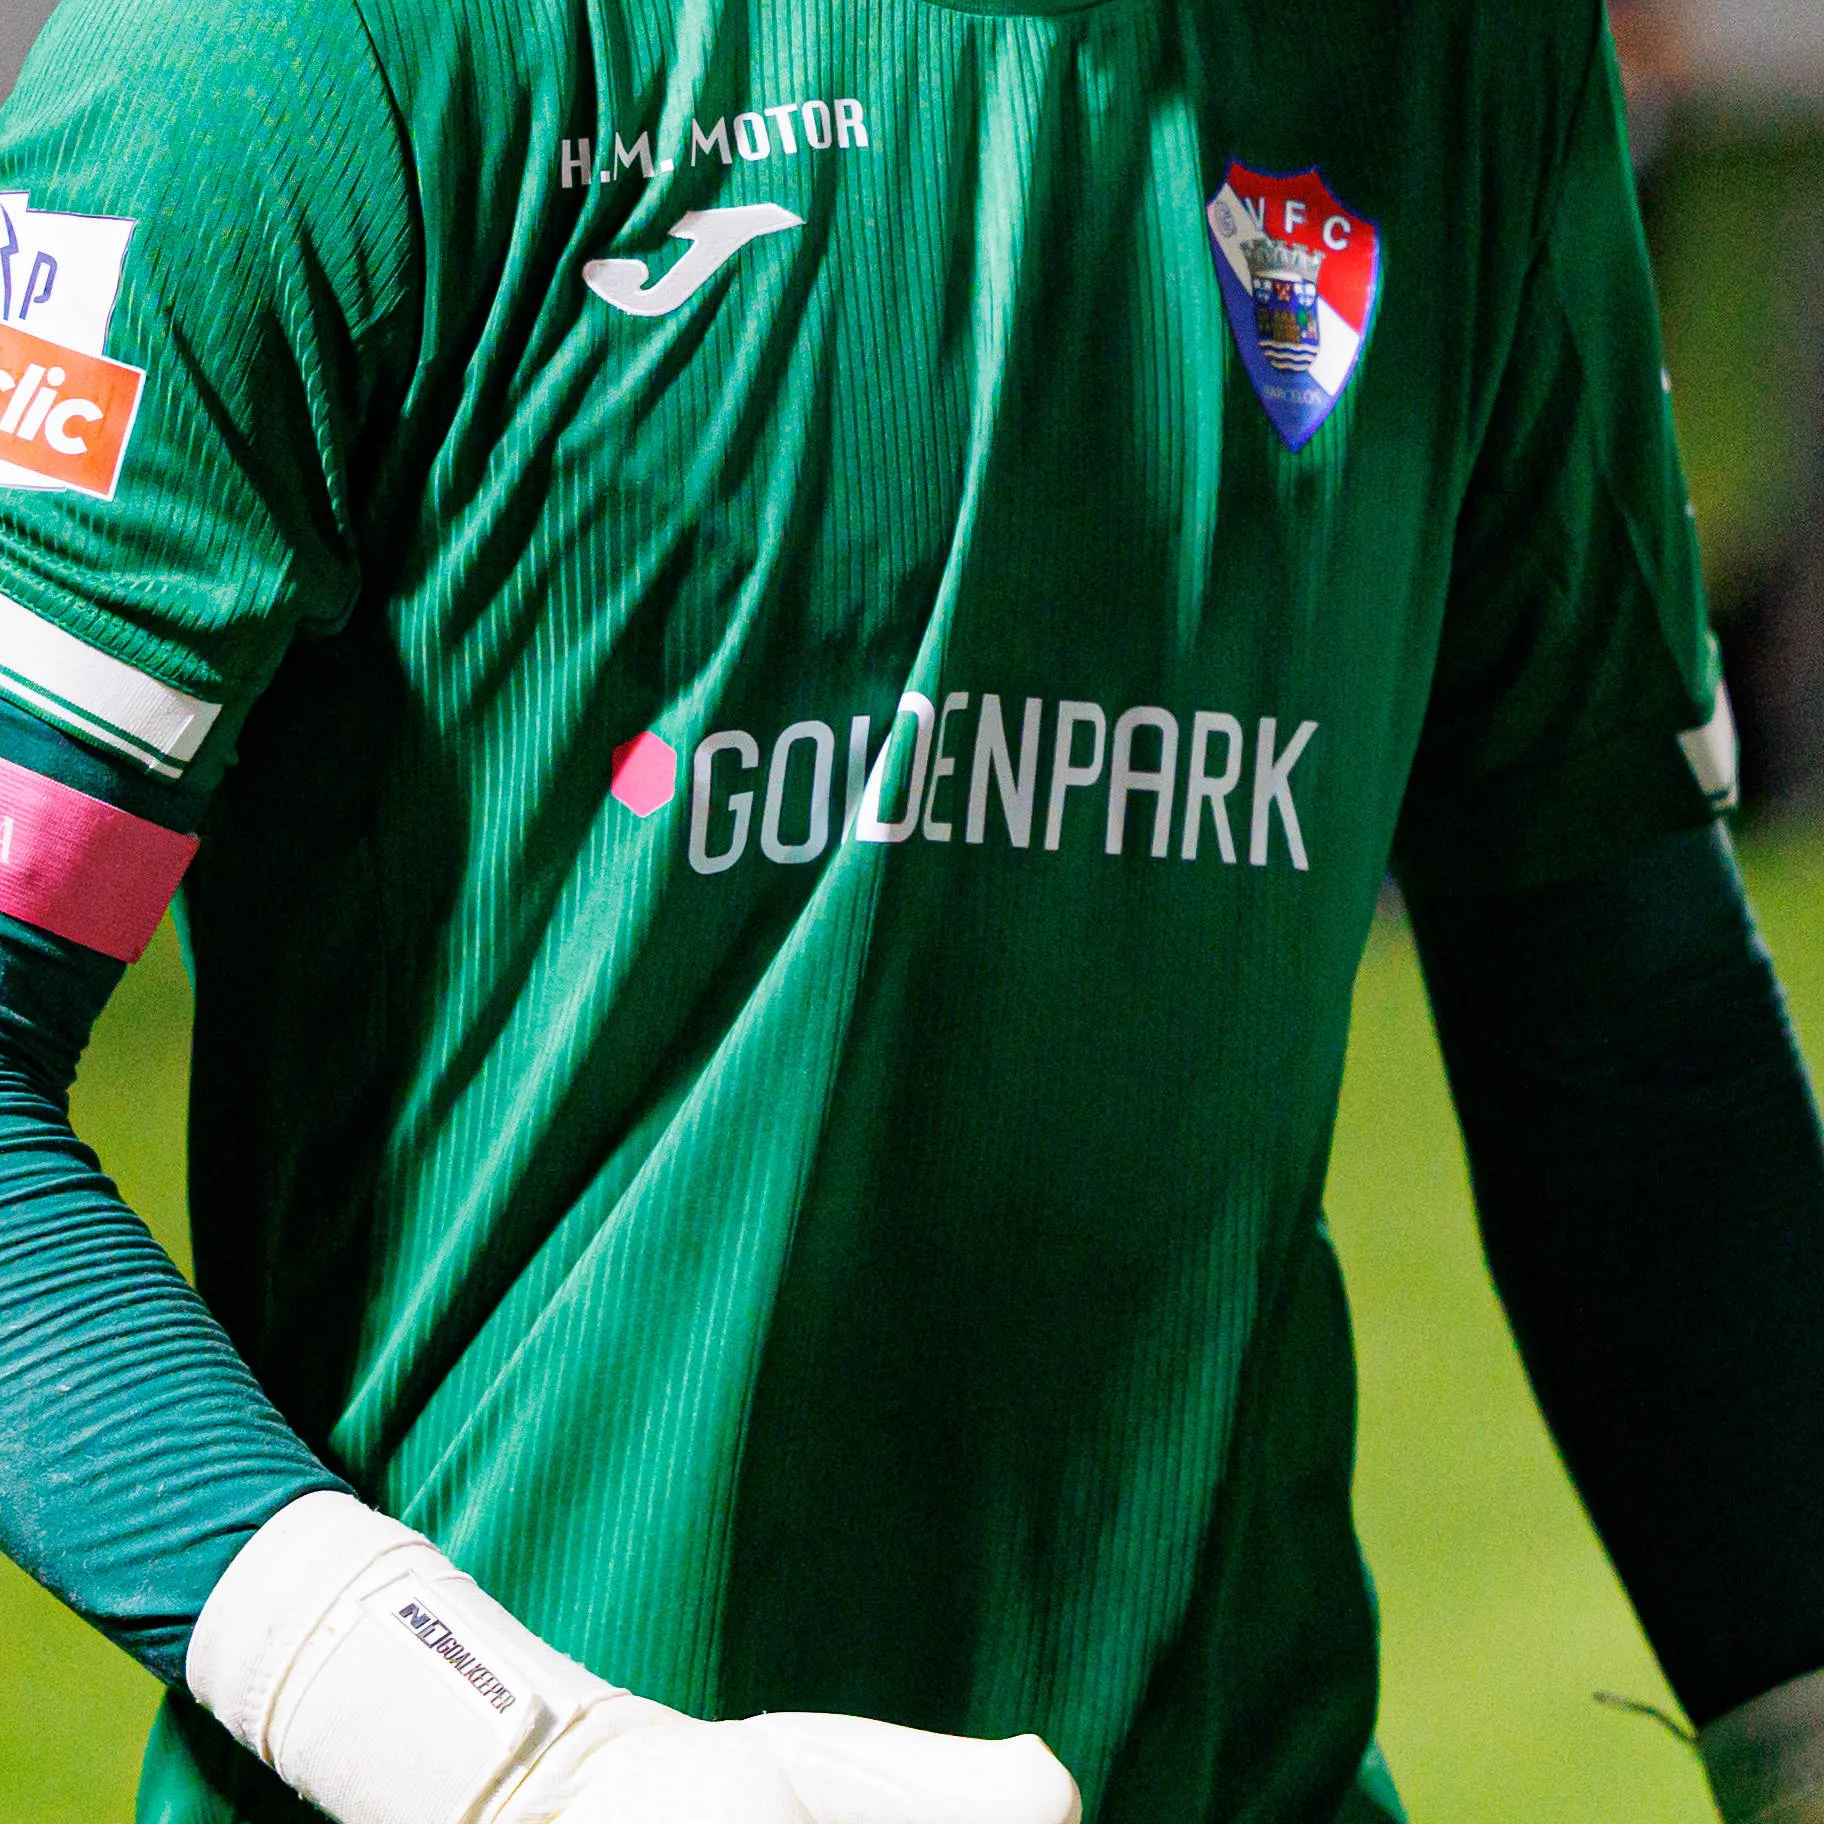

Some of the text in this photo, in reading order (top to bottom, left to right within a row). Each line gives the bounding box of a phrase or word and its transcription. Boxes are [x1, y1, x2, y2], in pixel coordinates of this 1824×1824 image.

[561, 97, 869, 189] H.M. MOTOR
[687, 689, 1320, 876] GOLDENPARK
[436, 1636, 517, 1715] GOALKEEPER
